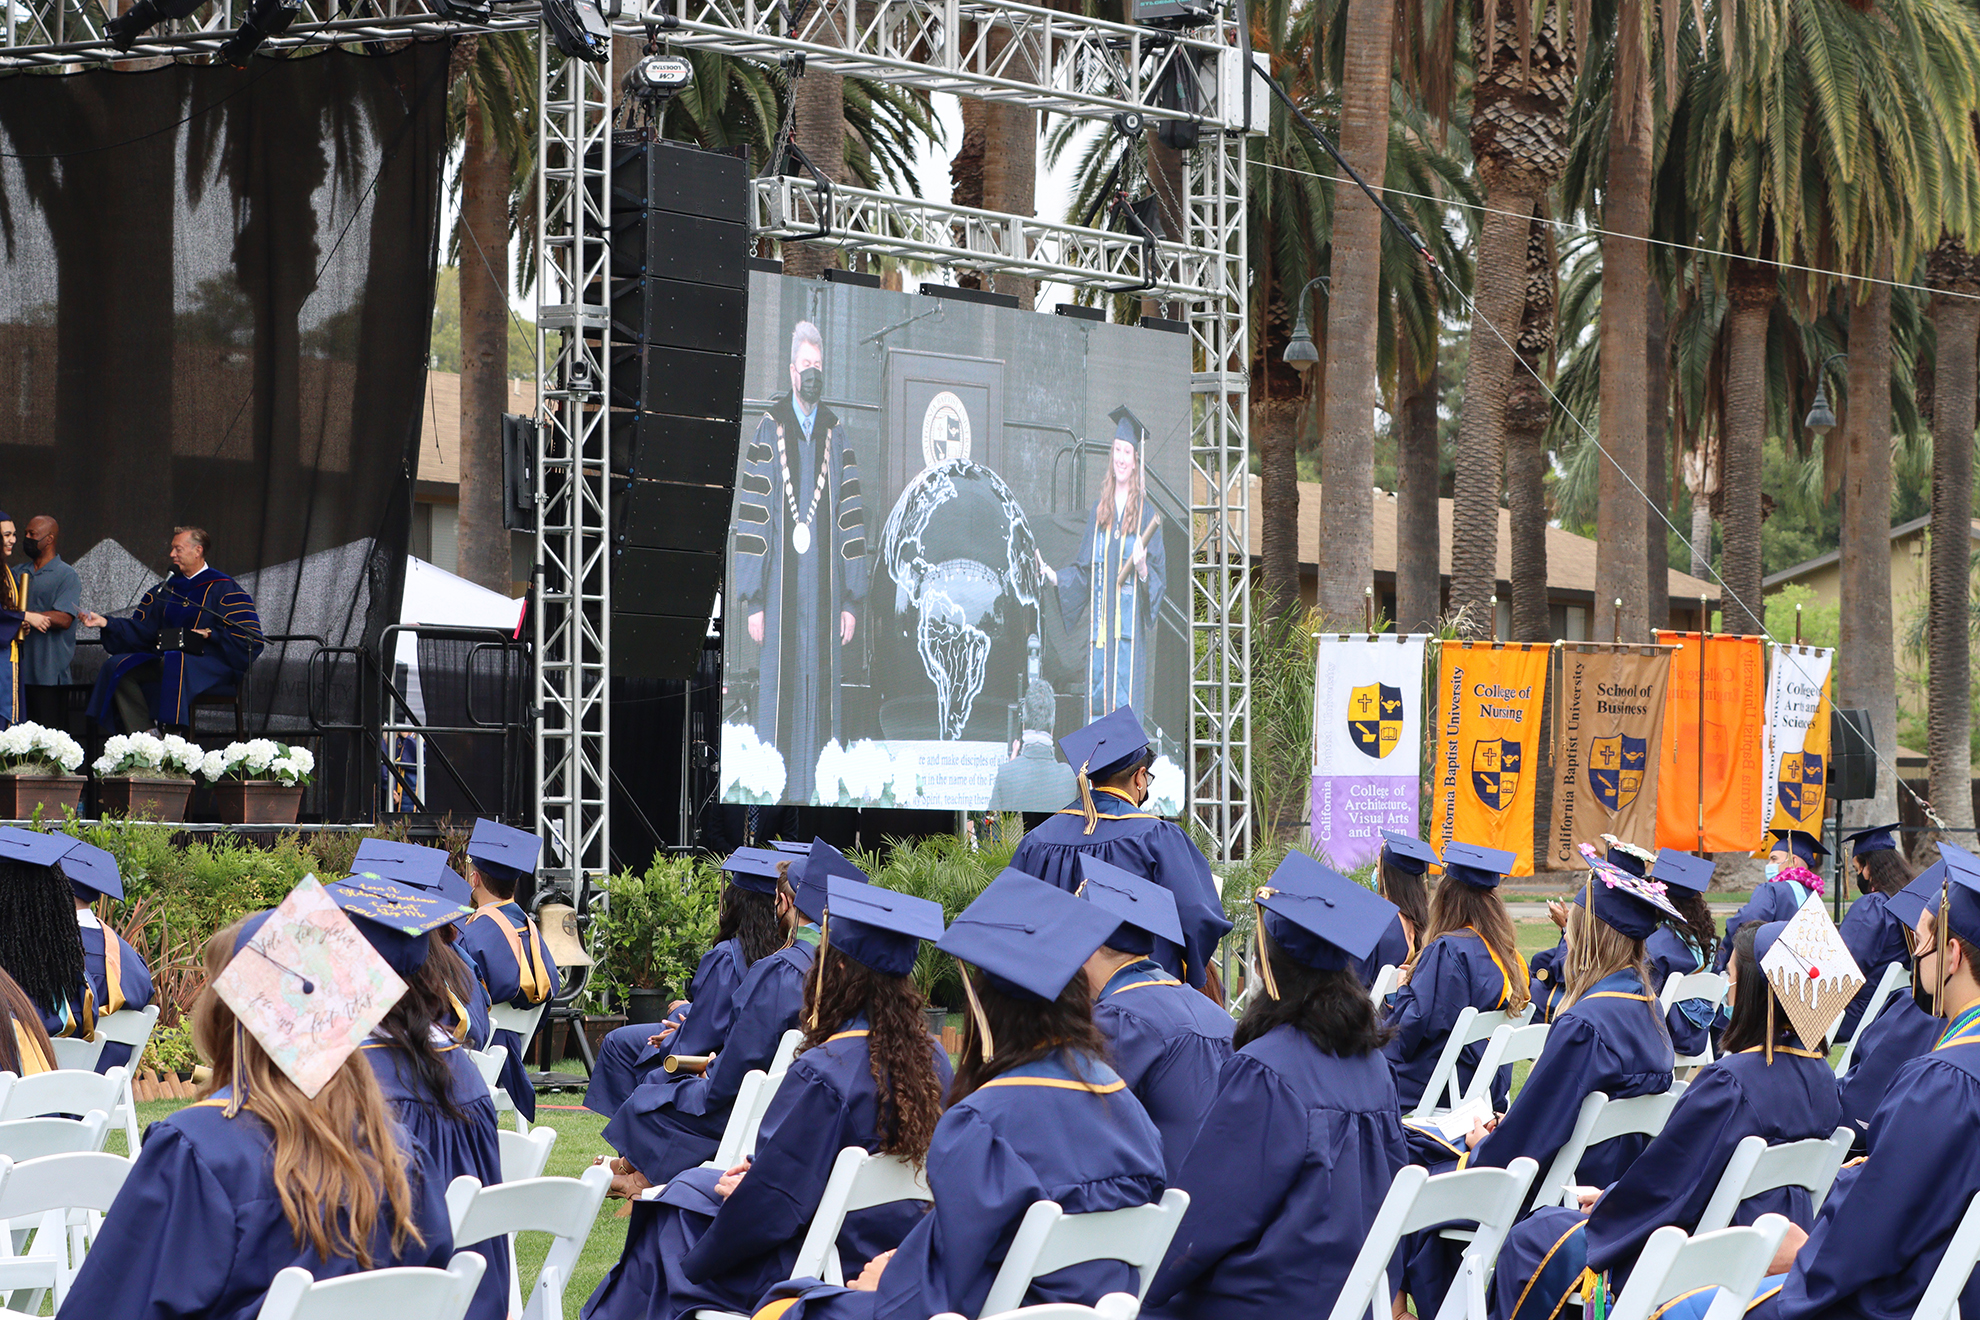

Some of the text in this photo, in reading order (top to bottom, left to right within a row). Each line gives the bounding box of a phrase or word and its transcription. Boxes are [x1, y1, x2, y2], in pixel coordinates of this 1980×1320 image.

[1473, 684, 1532, 701] College of
[1597, 682, 1653, 698] School of
[1447, 666, 1464, 736] University
[1596, 700, 1648, 715] Business
[1479, 704, 1523, 722] Nursing
[927, 754, 939, 765] and
[941, 754, 959, 765] make
[960, 755, 988, 768] disciples
[989, 755, 997, 766] of
[1444, 739, 1459, 789] Baptist
[1559, 661, 1585, 862] California Baptist University
[936, 773, 947, 785] the
[948, 776, 967, 785] name
[968, 774, 976, 785] of
[977, 774, 987, 785] the
[1350, 784, 1406, 799] College of
[944, 793, 972, 807] teaching
[1321, 780, 1332, 841] California
[1349, 812, 1409, 824] Visual Arts
[1349, 826, 1371, 838] and
[344, 904, 378, 917] CBU
[1797, 925, 1830, 946] BEEN
